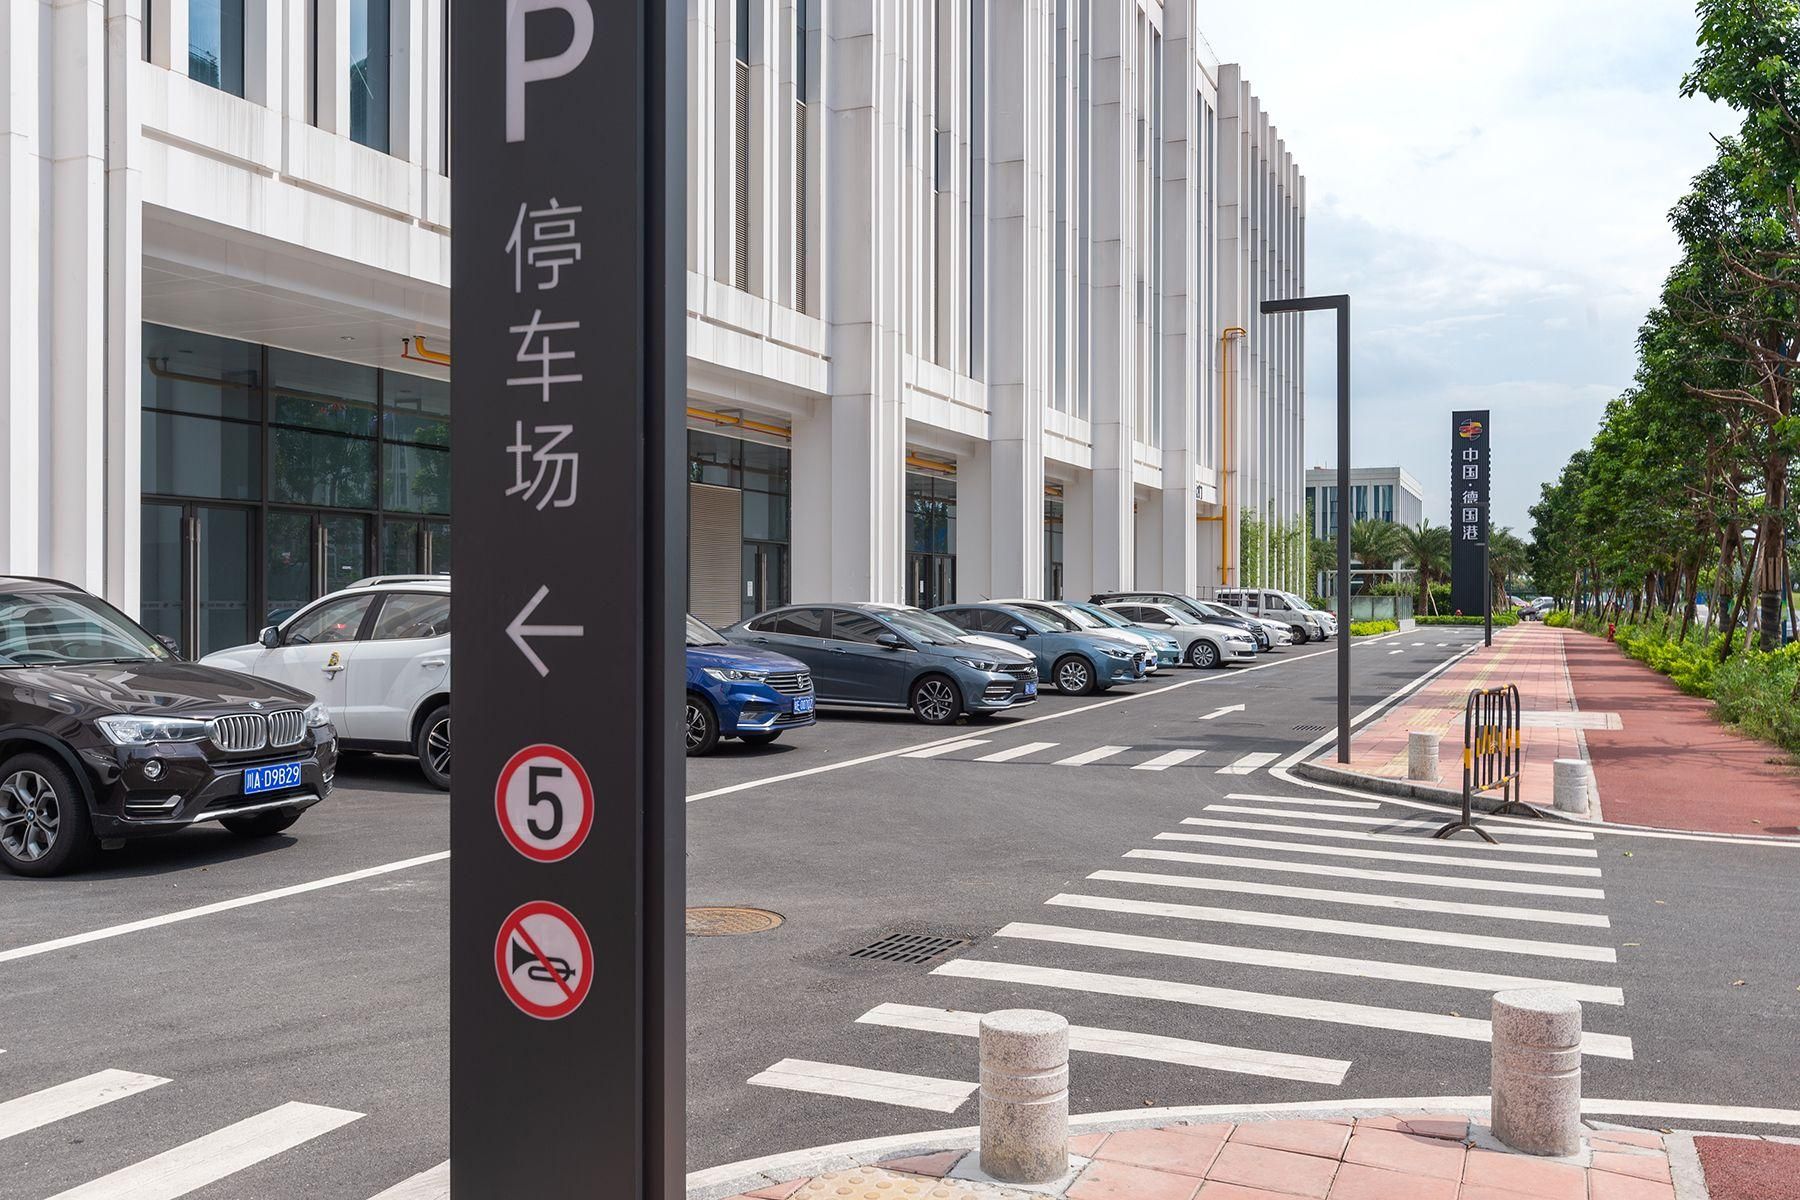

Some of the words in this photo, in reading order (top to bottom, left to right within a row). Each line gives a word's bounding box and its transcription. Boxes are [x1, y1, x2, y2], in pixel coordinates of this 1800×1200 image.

[506, 0, 593, 142] P
[505, 198, 583, 511] 停车场
[527, 766, 563, 840] 5
